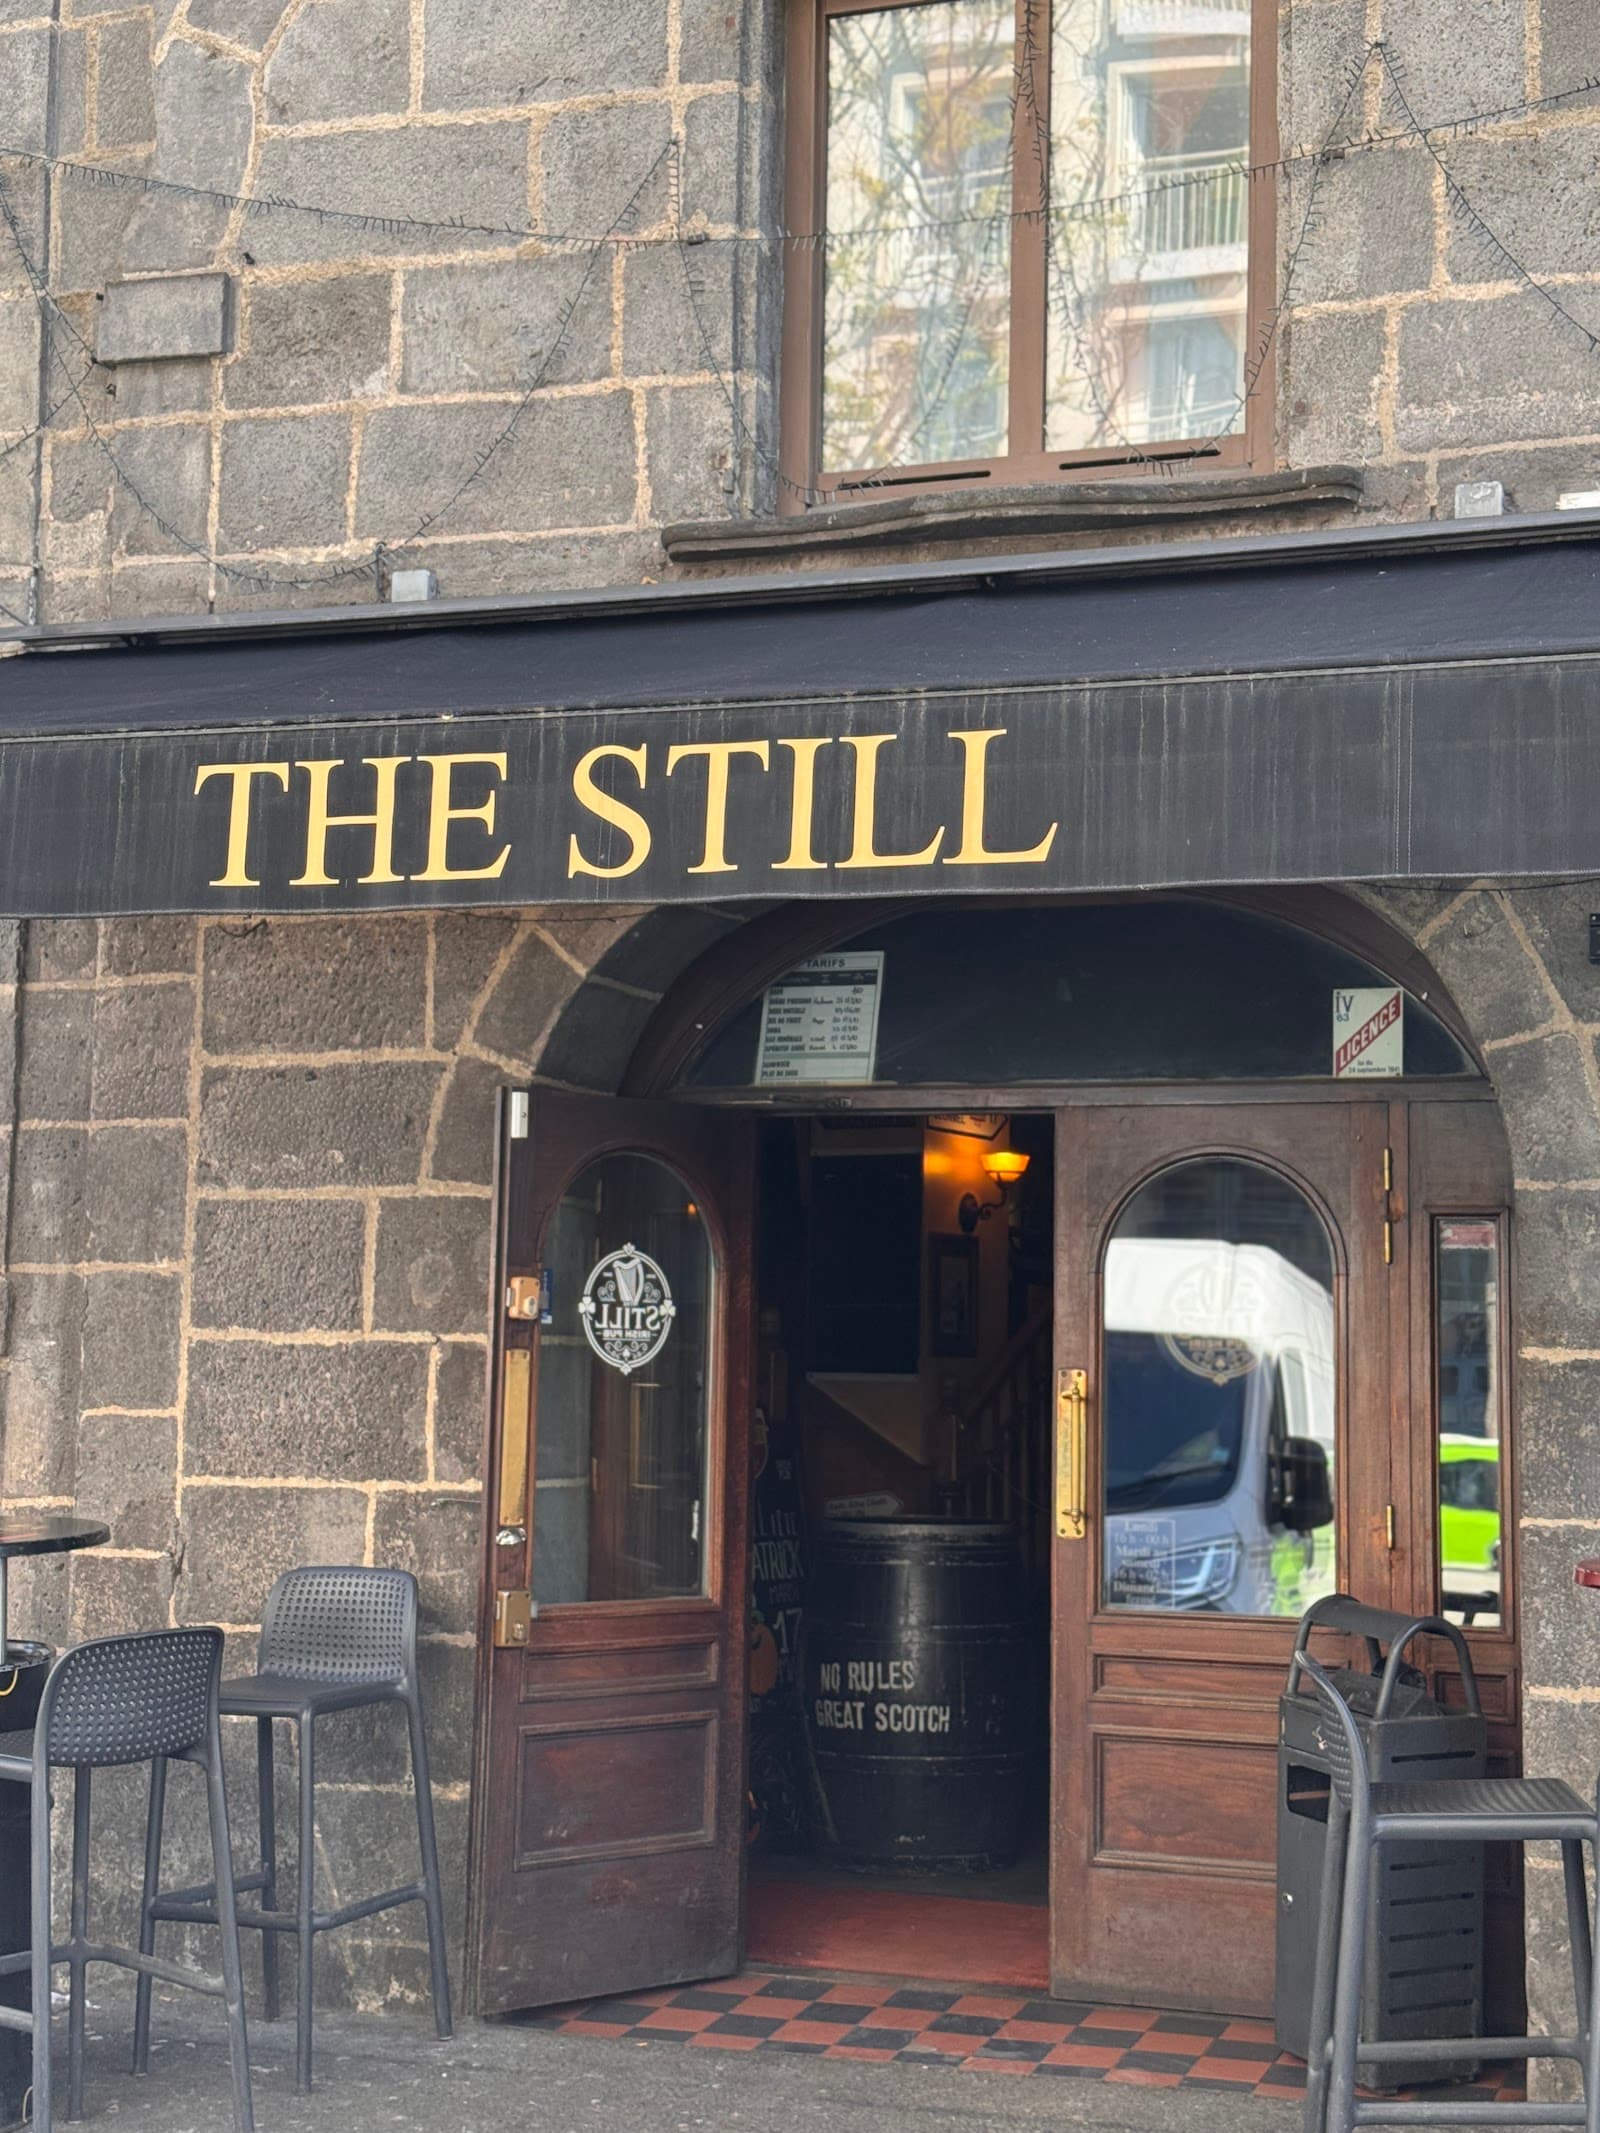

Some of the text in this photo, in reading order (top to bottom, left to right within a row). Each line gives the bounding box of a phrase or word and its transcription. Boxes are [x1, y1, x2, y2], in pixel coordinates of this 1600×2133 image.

[194, 729, 1058, 888] THE STILL
[806, 958, 846, 968] TARIFS
[1340, 999, 1396, 1068] LICENCE
[821, 1662, 841, 1693] NO
[847, 1660, 915, 1694] RULES
[815, 1699, 951, 1734] GREAT SCOTCH
